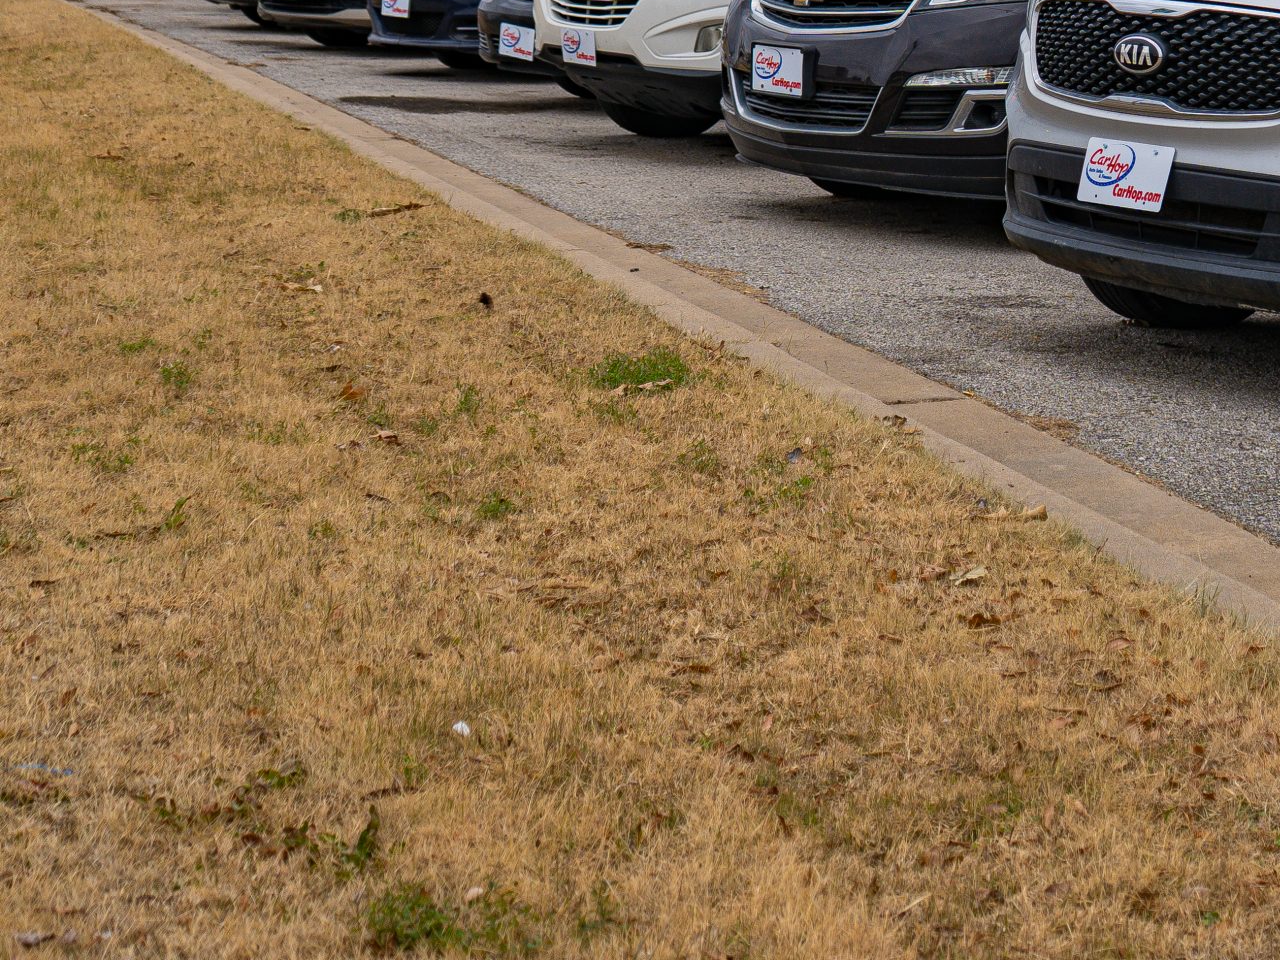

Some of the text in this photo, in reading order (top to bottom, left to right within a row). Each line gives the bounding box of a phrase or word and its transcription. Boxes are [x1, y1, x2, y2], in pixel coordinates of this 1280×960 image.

[1120, 43, 1153, 66] KIA
[1090, 148, 1129, 180] CarHop
[1112, 183, 1161, 203] CarHop.com
